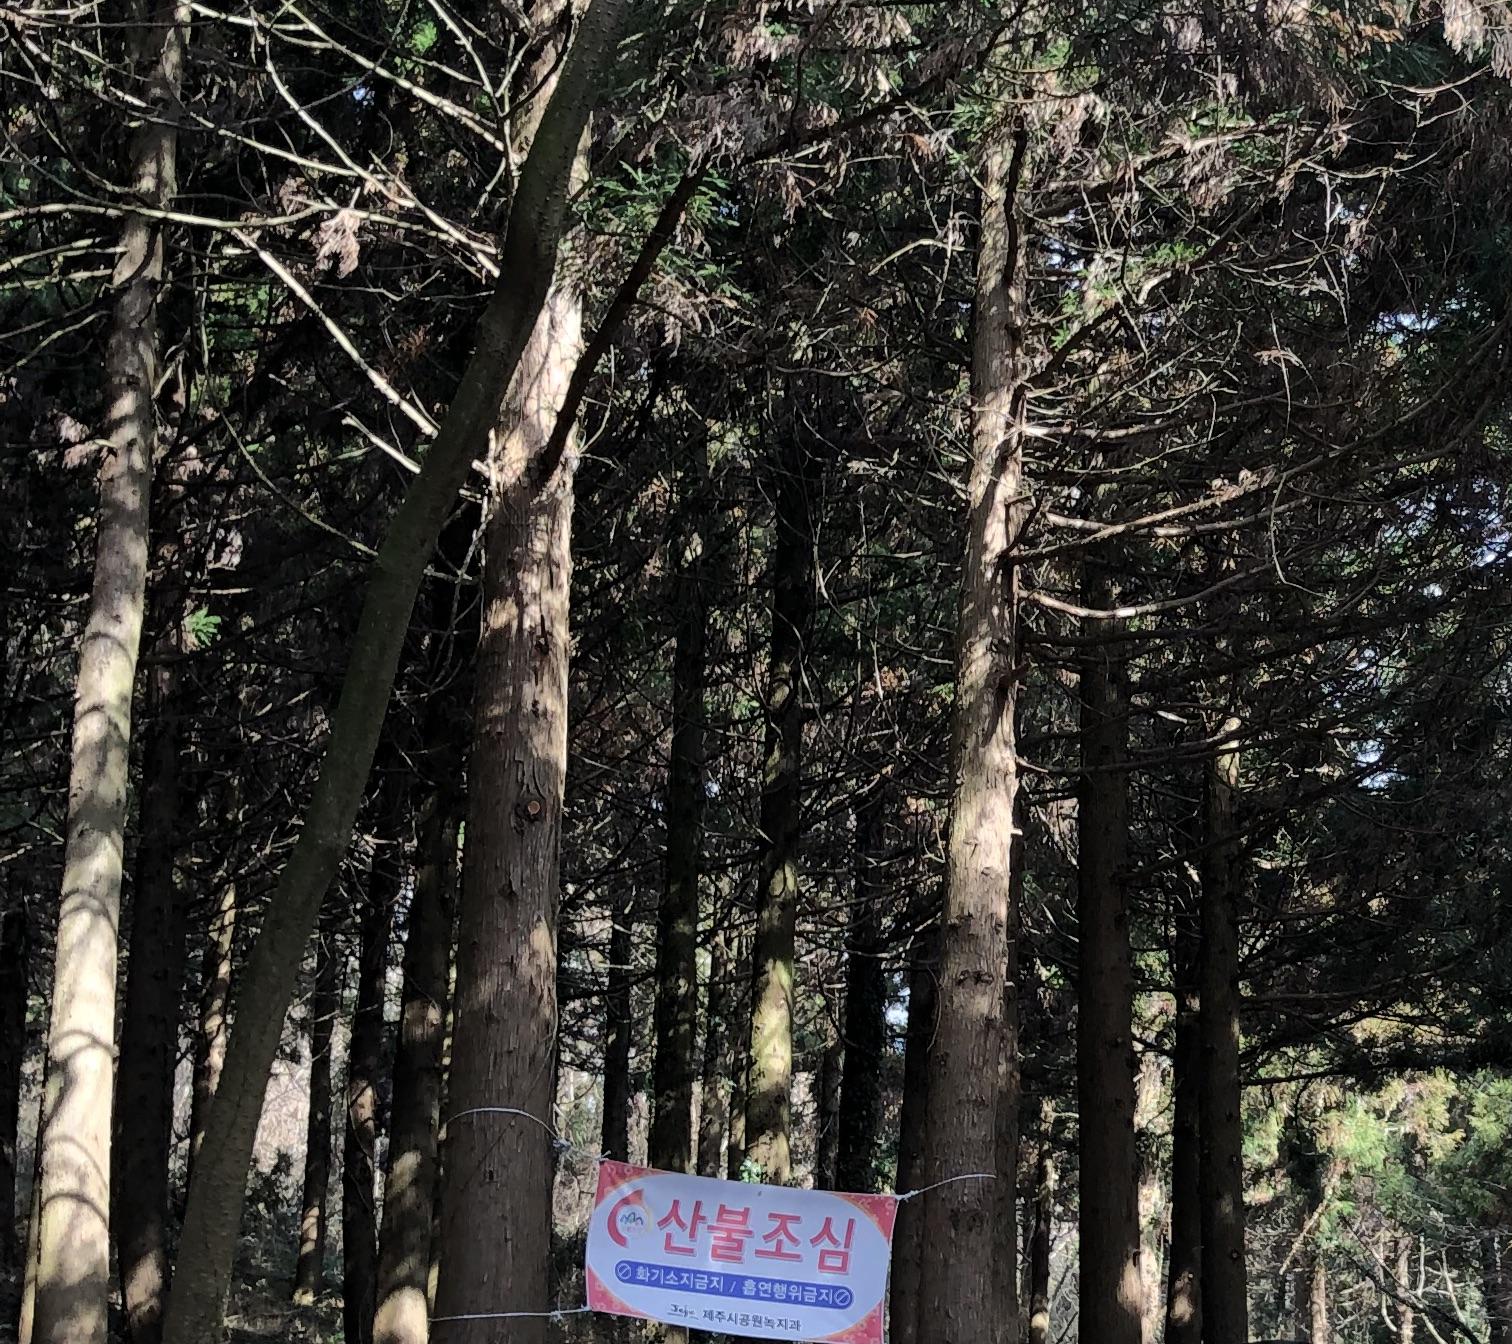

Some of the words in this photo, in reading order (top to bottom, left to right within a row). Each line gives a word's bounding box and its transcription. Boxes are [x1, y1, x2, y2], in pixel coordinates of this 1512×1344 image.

[656, 1199, 856, 1274] 산불조심
[636, 1265, 724, 1292] 화기소지금지
[742, 1278, 833, 1305] 흡연행위금지
[702, 1309, 801, 1331] 제주시공원녹지과
